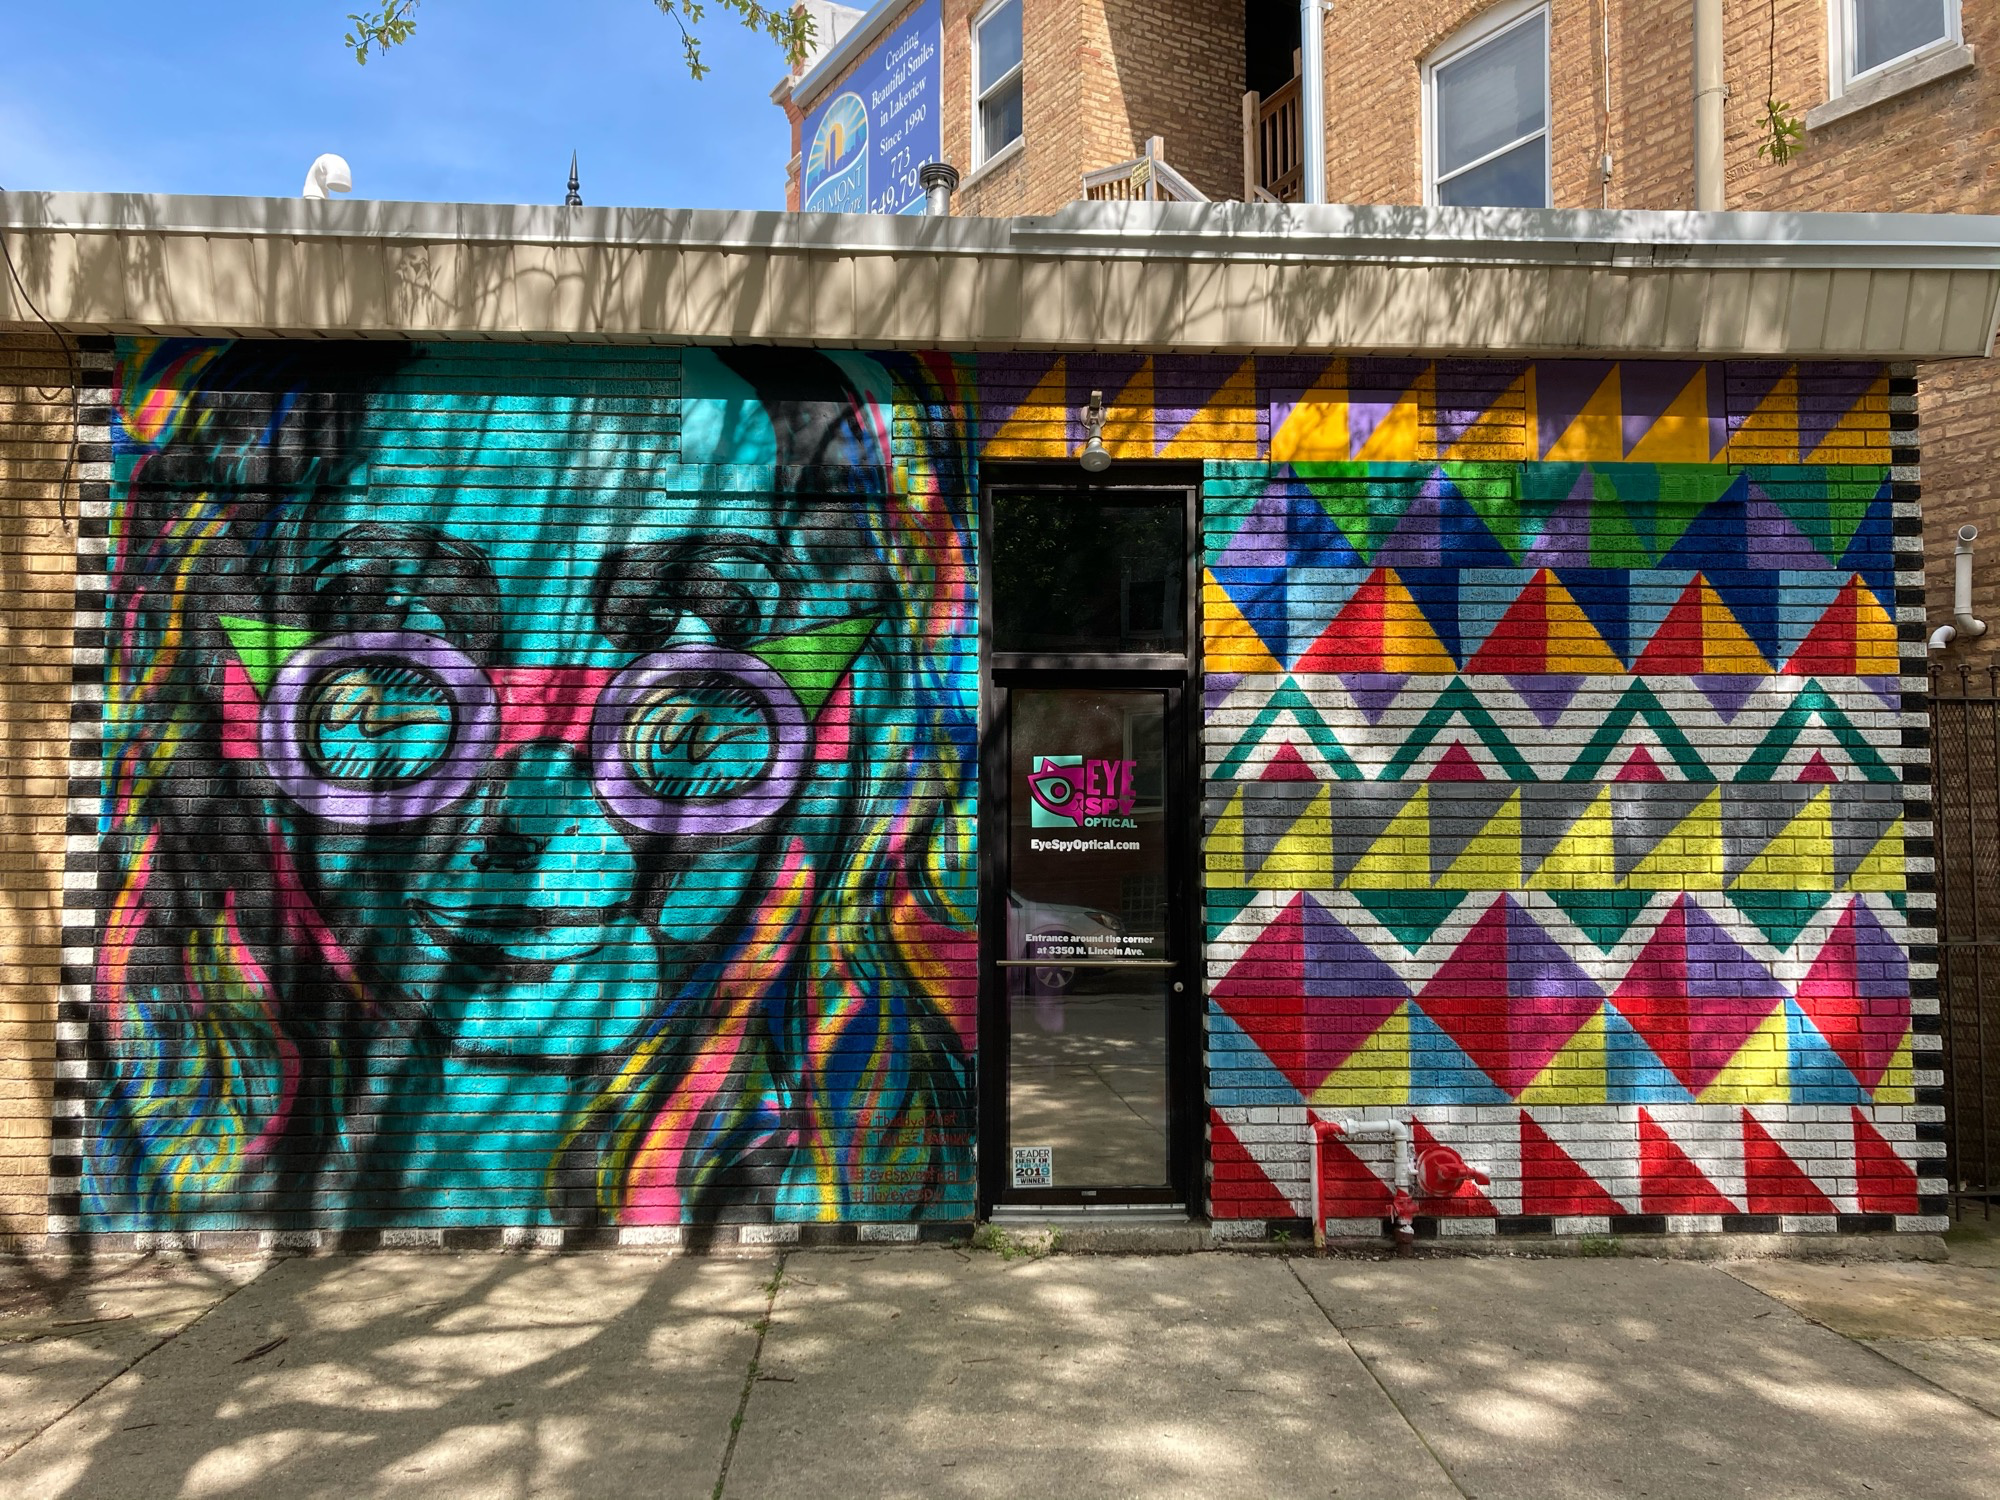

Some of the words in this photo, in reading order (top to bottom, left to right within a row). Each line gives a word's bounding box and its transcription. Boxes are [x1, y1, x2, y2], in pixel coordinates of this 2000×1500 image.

[886, 31, 919, 71] Creating
[872, 62, 906, 111] Beautiful
[907, 43, 934, 76] Smiles
[880, 110, 888, 127] in
[890, 76, 927, 119] Lakeview
[880, 129, 902, 156] Since
[905, 104, 926, 135] 1990
[891, 145, 910, 179] 773
[1086, 760, 1137, 796] EYE
[1084, 797, 1136, 816] SPY
[1084, 817, 1138, 829] OPTICAL
[1030, 839, 1140, 851] EyeSpyOptical.com
[1025, 934, 1069, 943] Entrance
[1070, 935, 1103, 943] around
[1105, 935, 1121, 943] the
[1123, 936, 1154, 944] corner
[1049, 946, 1075, 955] 3350
[1076, 947, 1086, 955] N.
[1088, 947, 1123, 955] Lincoln
[1124, 947, 1145, 956] Ave.
[1015, 1149, 1050, 1158] READER
[1015, 1167, 1050, 1177] 2019
